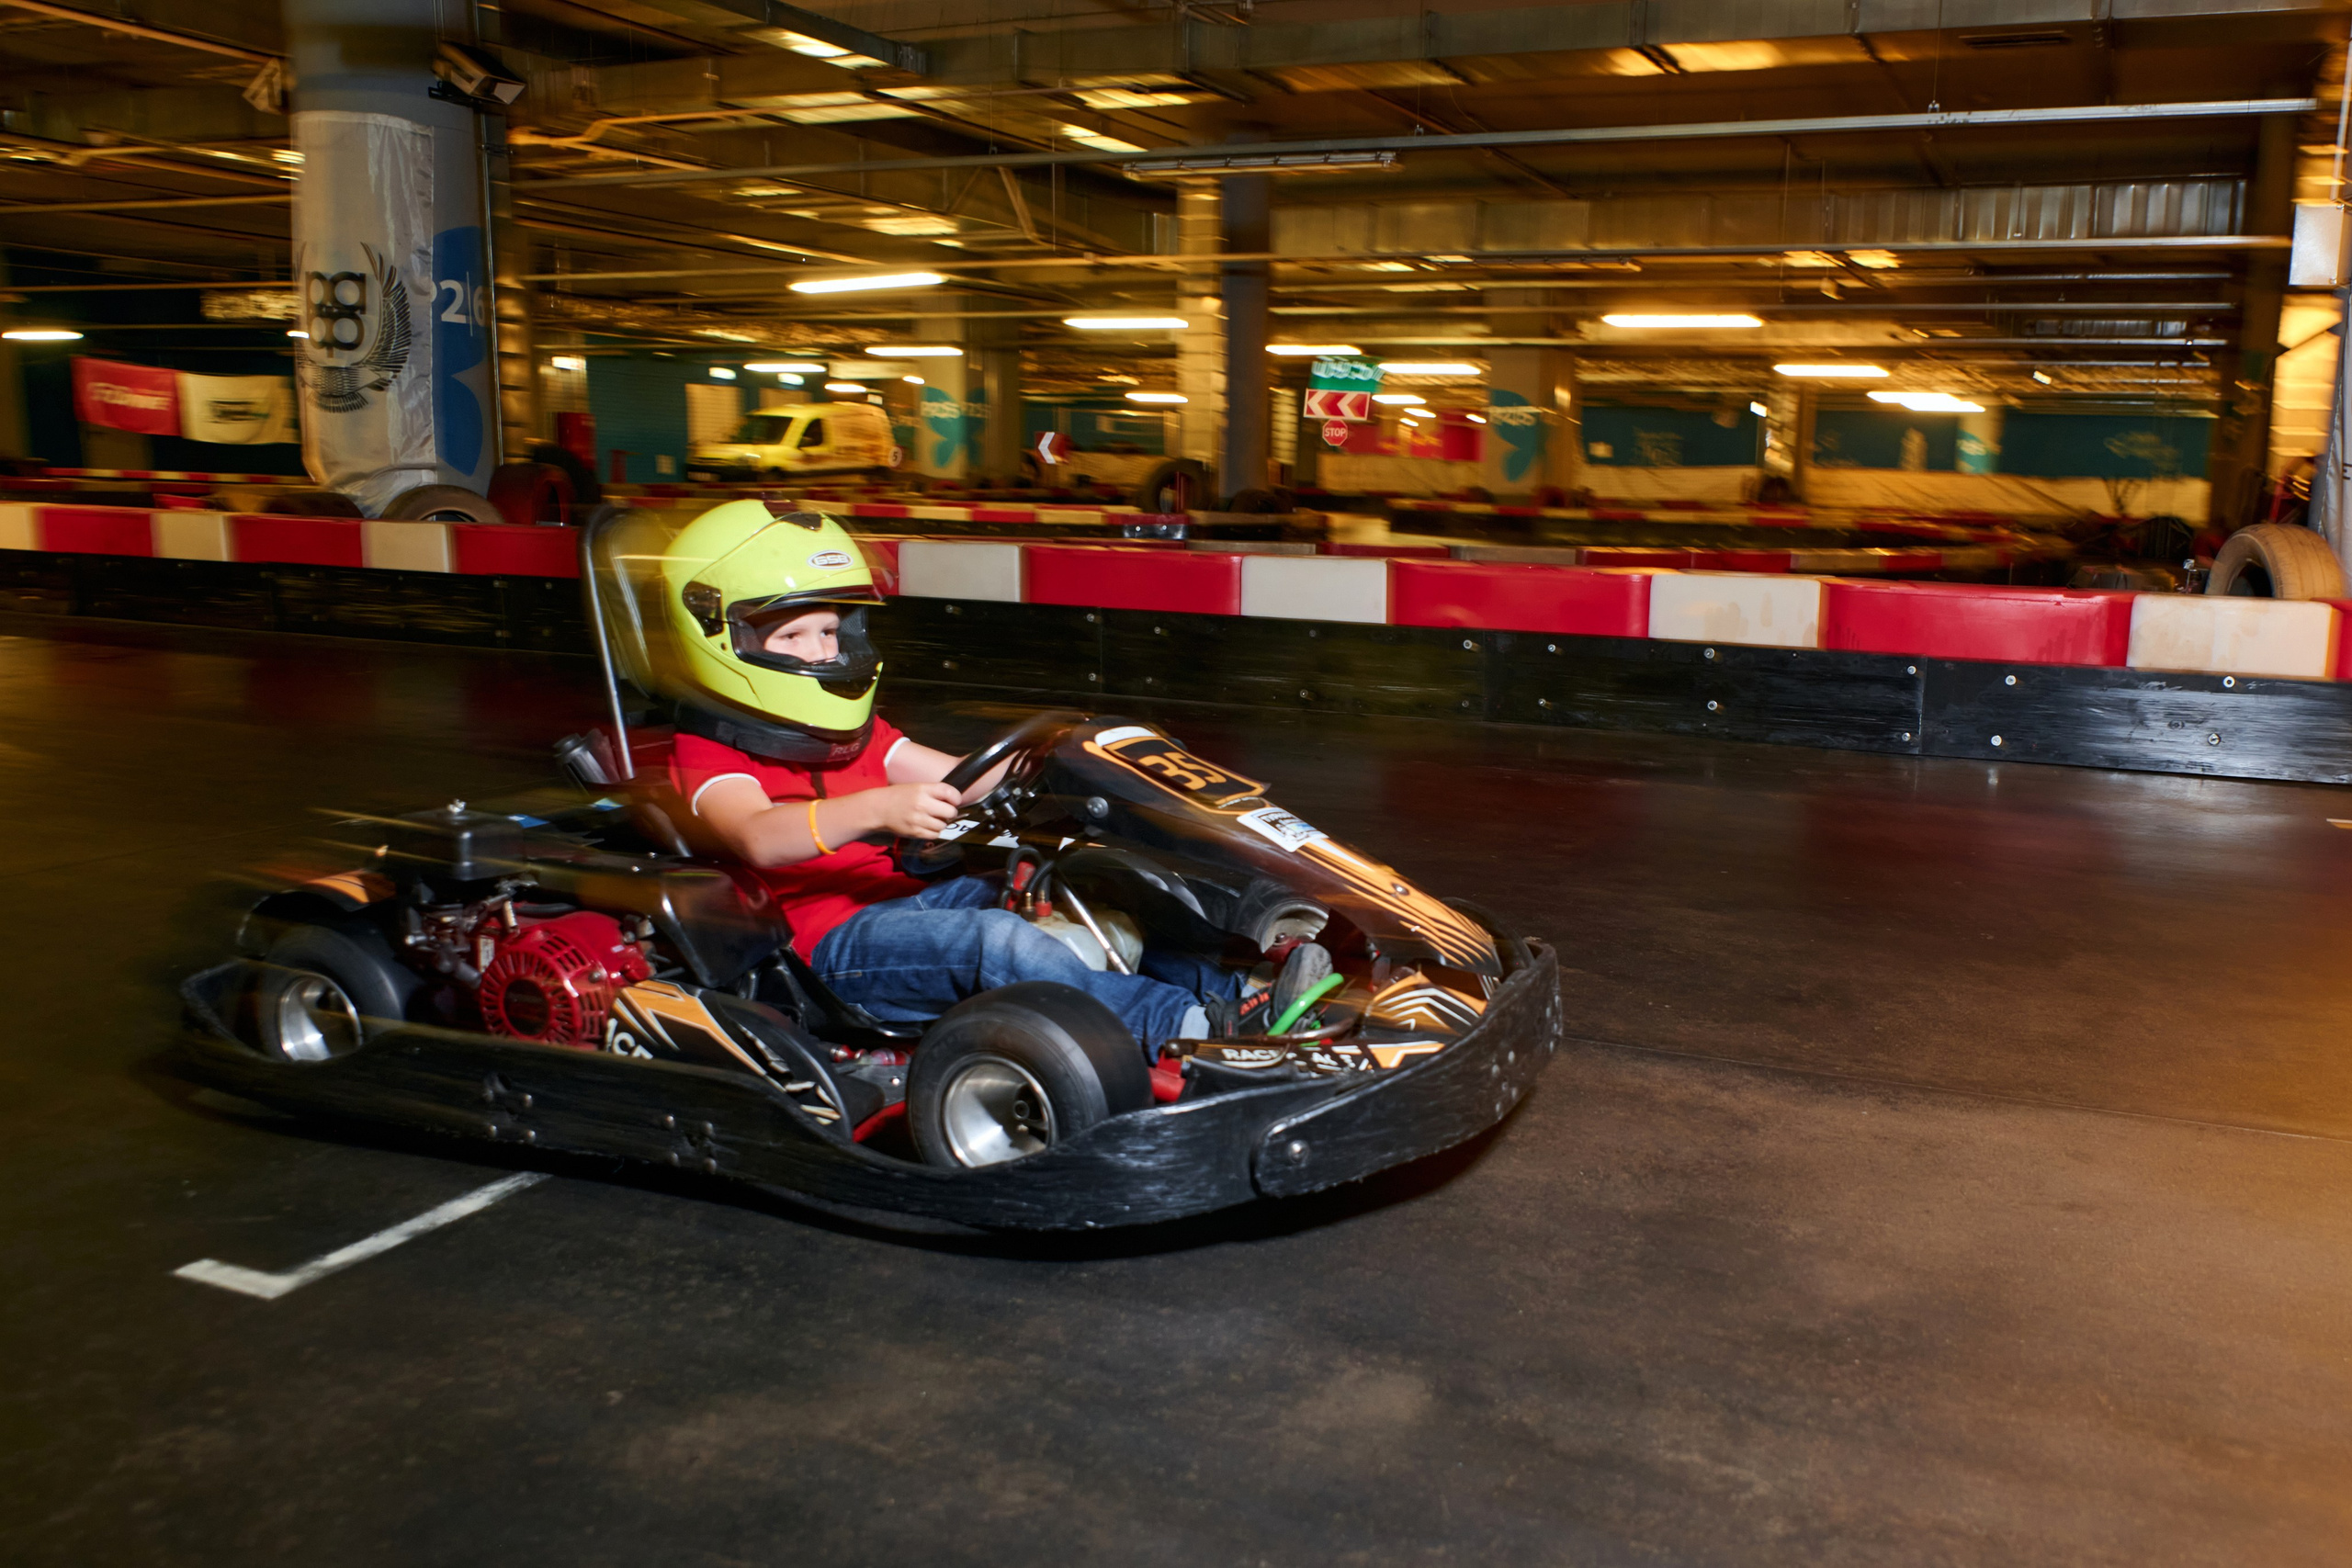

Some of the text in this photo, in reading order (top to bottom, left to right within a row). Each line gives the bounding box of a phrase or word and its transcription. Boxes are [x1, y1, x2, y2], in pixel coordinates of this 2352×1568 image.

[1324, 427, 1347, 437] STOP
[892, 451, 898, 461] 5
[1138, 751, 1227, 790] 35
